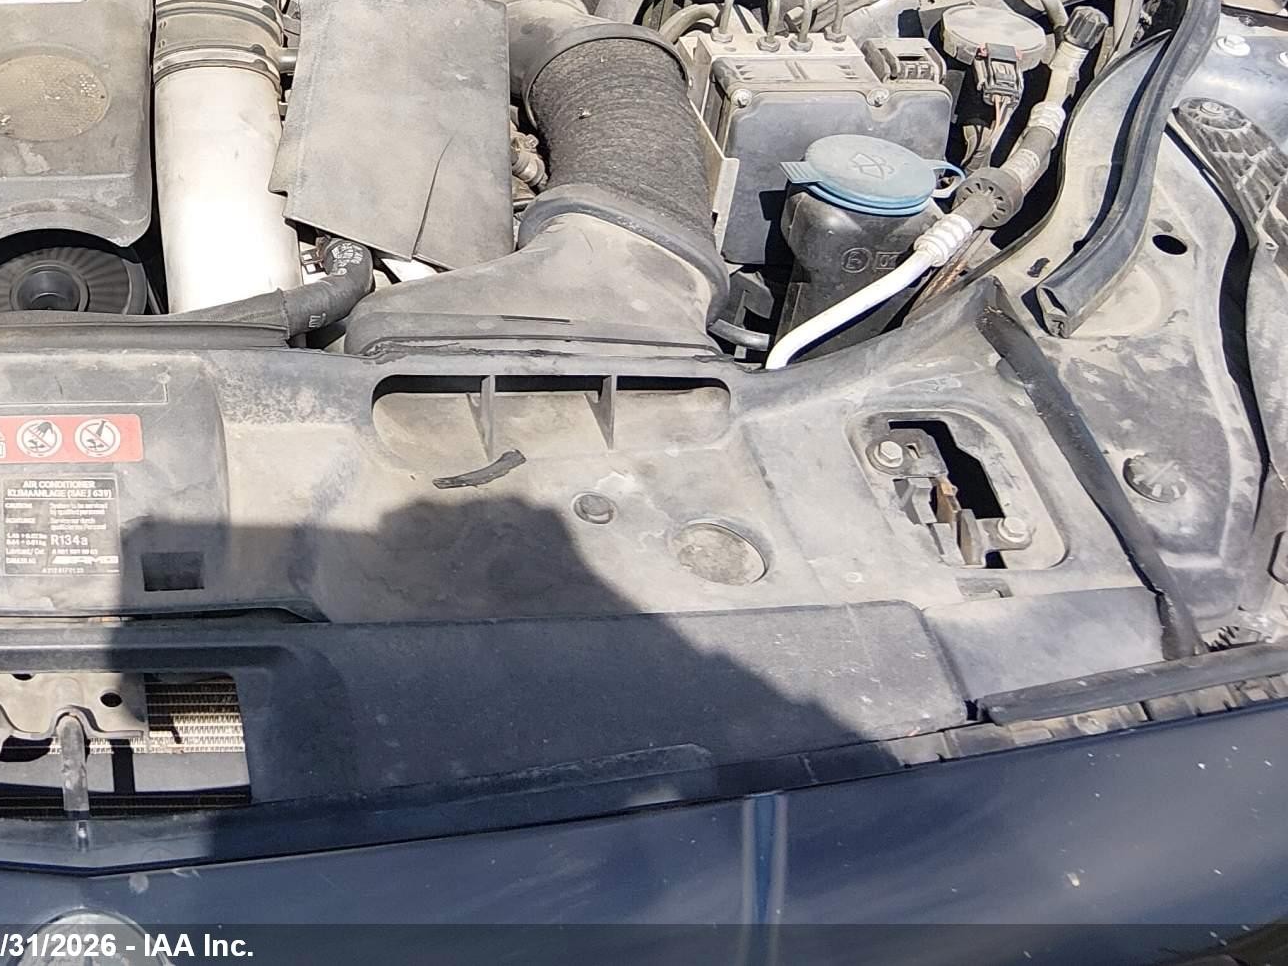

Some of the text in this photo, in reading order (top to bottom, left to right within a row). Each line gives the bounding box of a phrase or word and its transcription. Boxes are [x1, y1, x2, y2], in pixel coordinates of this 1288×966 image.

[22, 480, 96, 489] AIR CONDITIONER
[7, 488, 66, 498] KLIMAANLAGE
[51, 534, 88, 546] R134a
